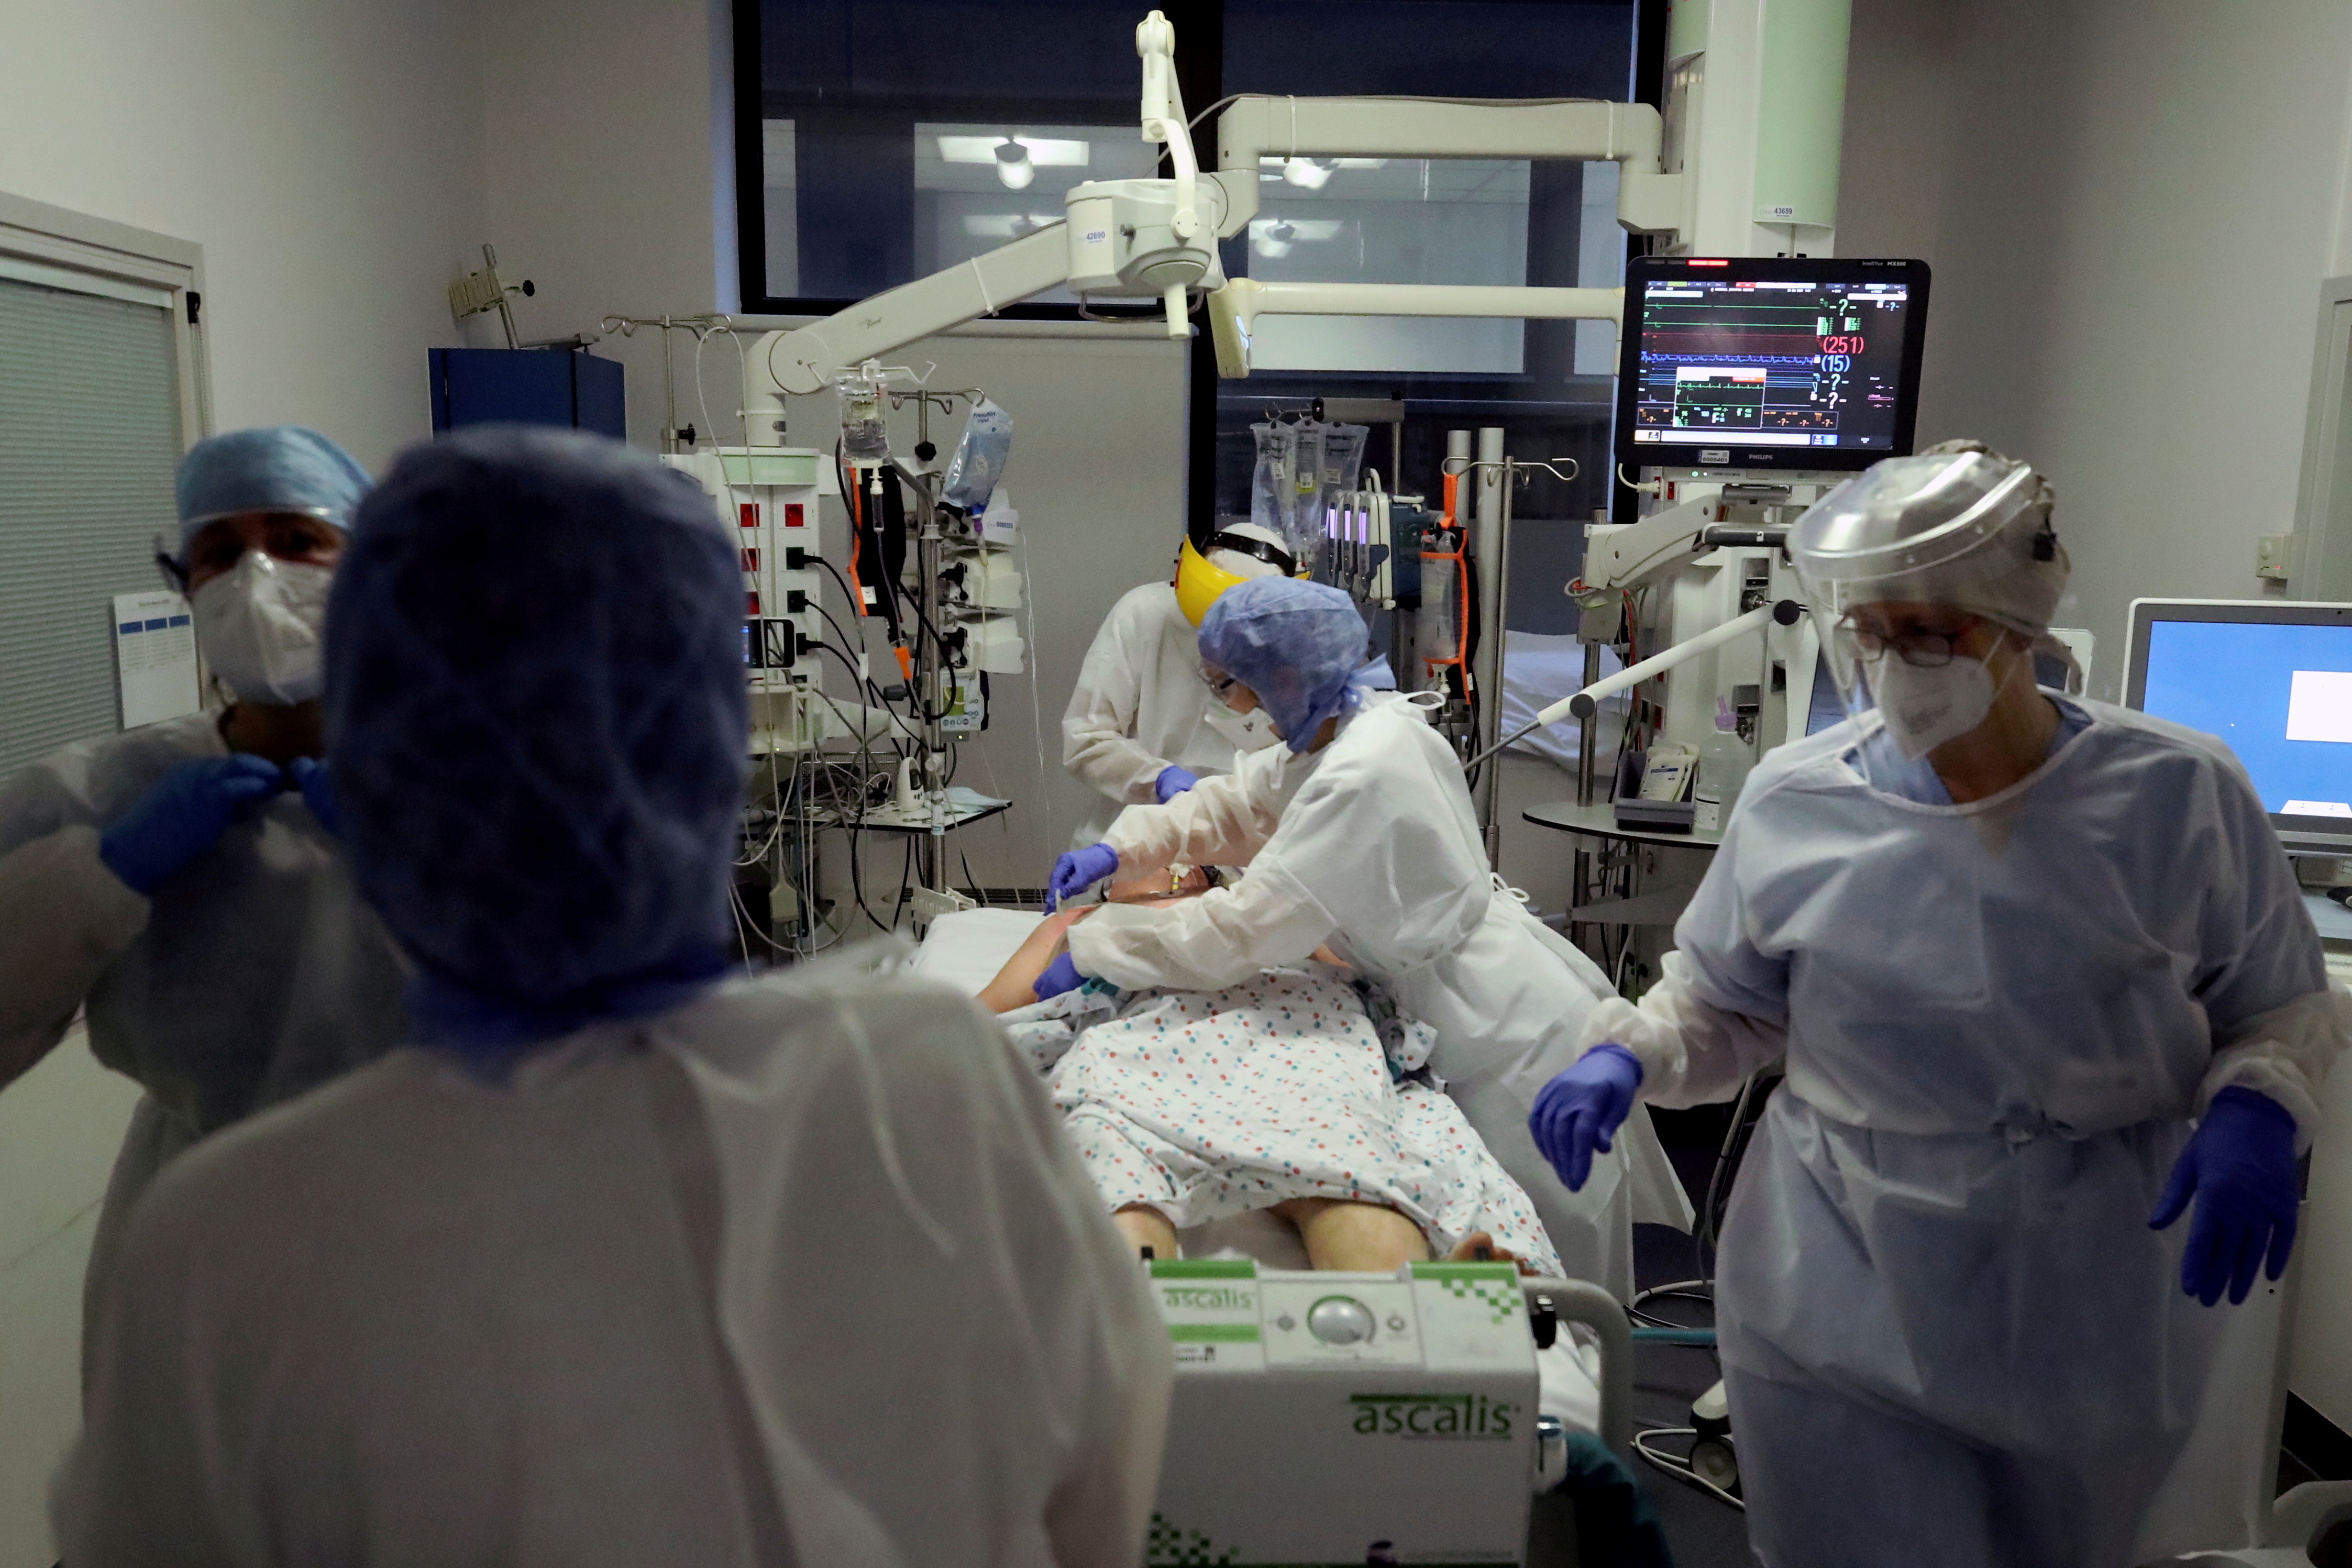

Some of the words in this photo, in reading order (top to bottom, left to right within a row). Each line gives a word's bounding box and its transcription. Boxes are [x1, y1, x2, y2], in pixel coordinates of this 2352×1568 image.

[1086, 231, 1105, 240] 42690
[1823, 336, 1864, 354] (251)
[1821, 355, 1851, 372] (15)
[1166, 1288, 1252, 1309] ascalis
[1353, 1393, 1512, 1434] ascalis
